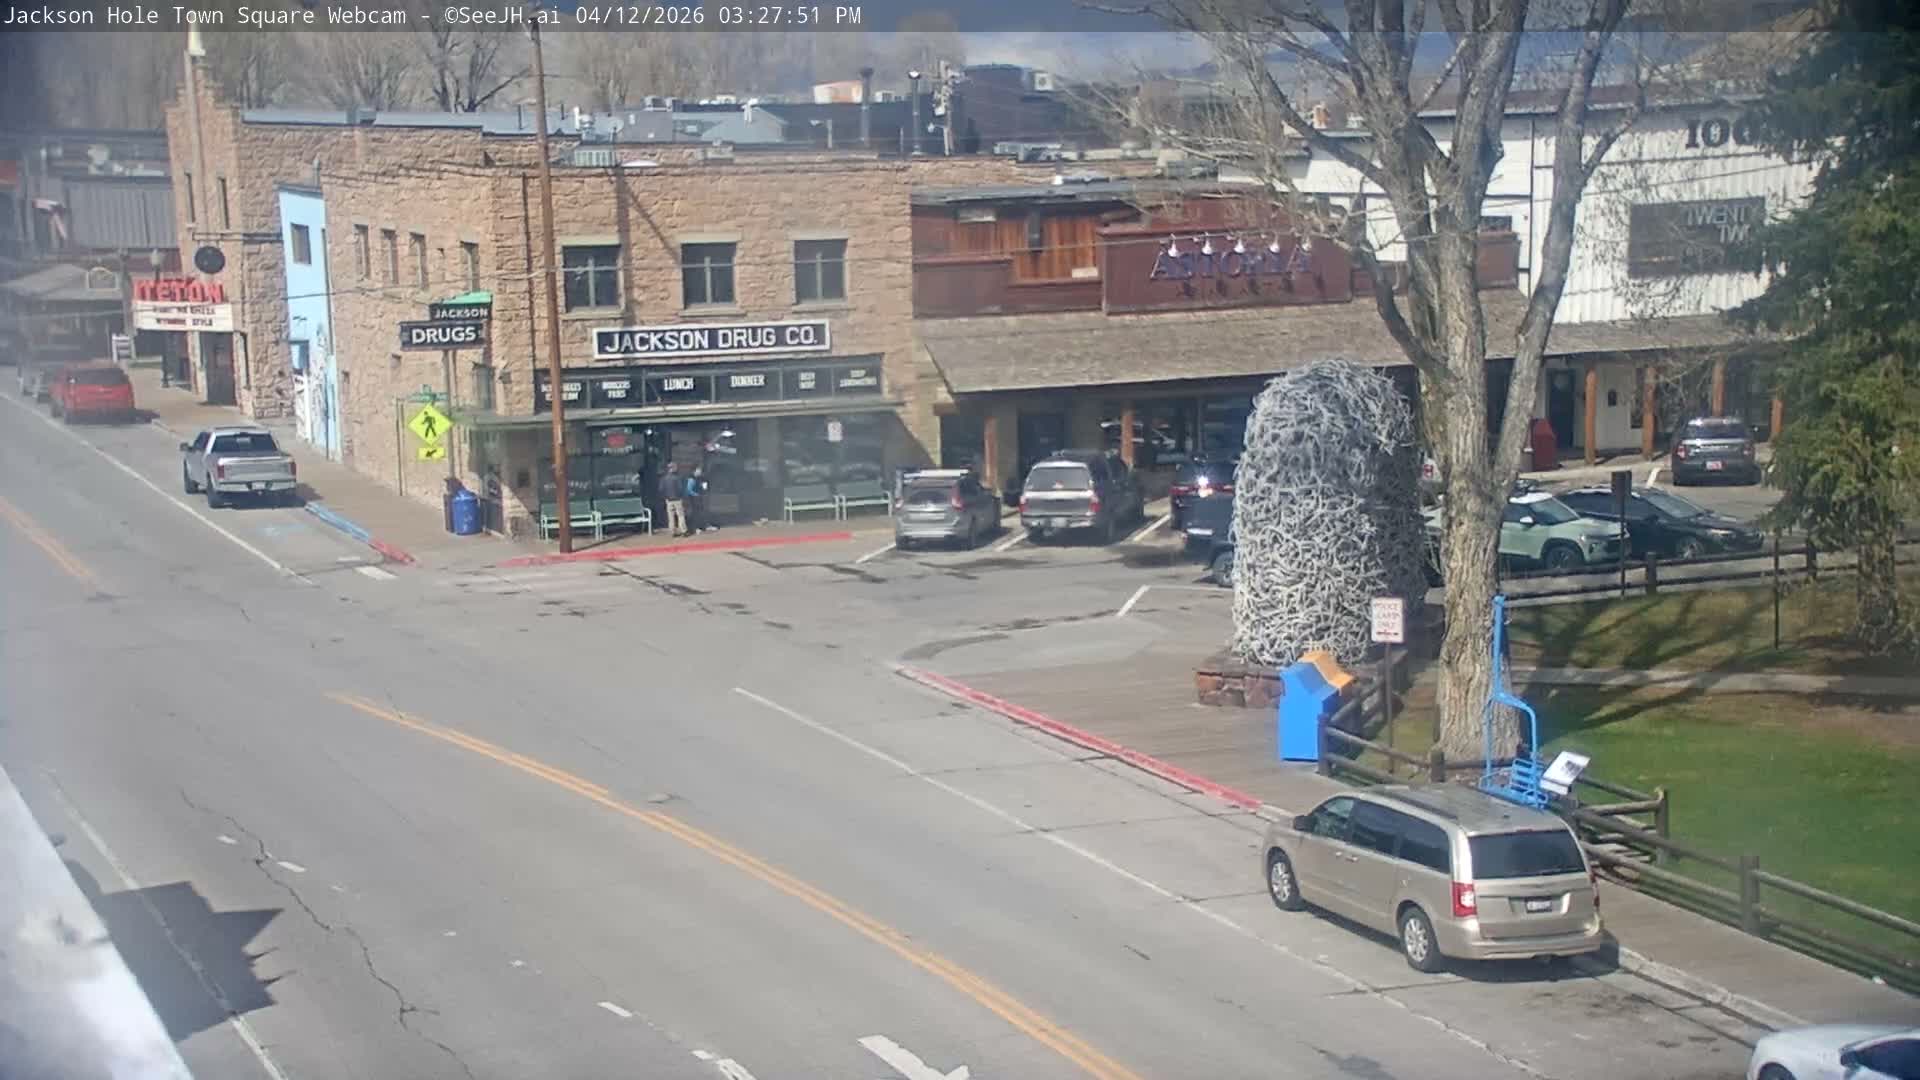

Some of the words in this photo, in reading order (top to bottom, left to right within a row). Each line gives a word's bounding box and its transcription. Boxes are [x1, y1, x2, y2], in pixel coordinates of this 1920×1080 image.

[435, 309, 489, 319] JACKSON
[411, 326, 477, 344] DRUGS
[604, 330, 708, 353] JACKSON
[718, 327, 776, 348] DRUG
[785, 326, 818, 345] CO.
[730, 375, 766, 388] DINNER
